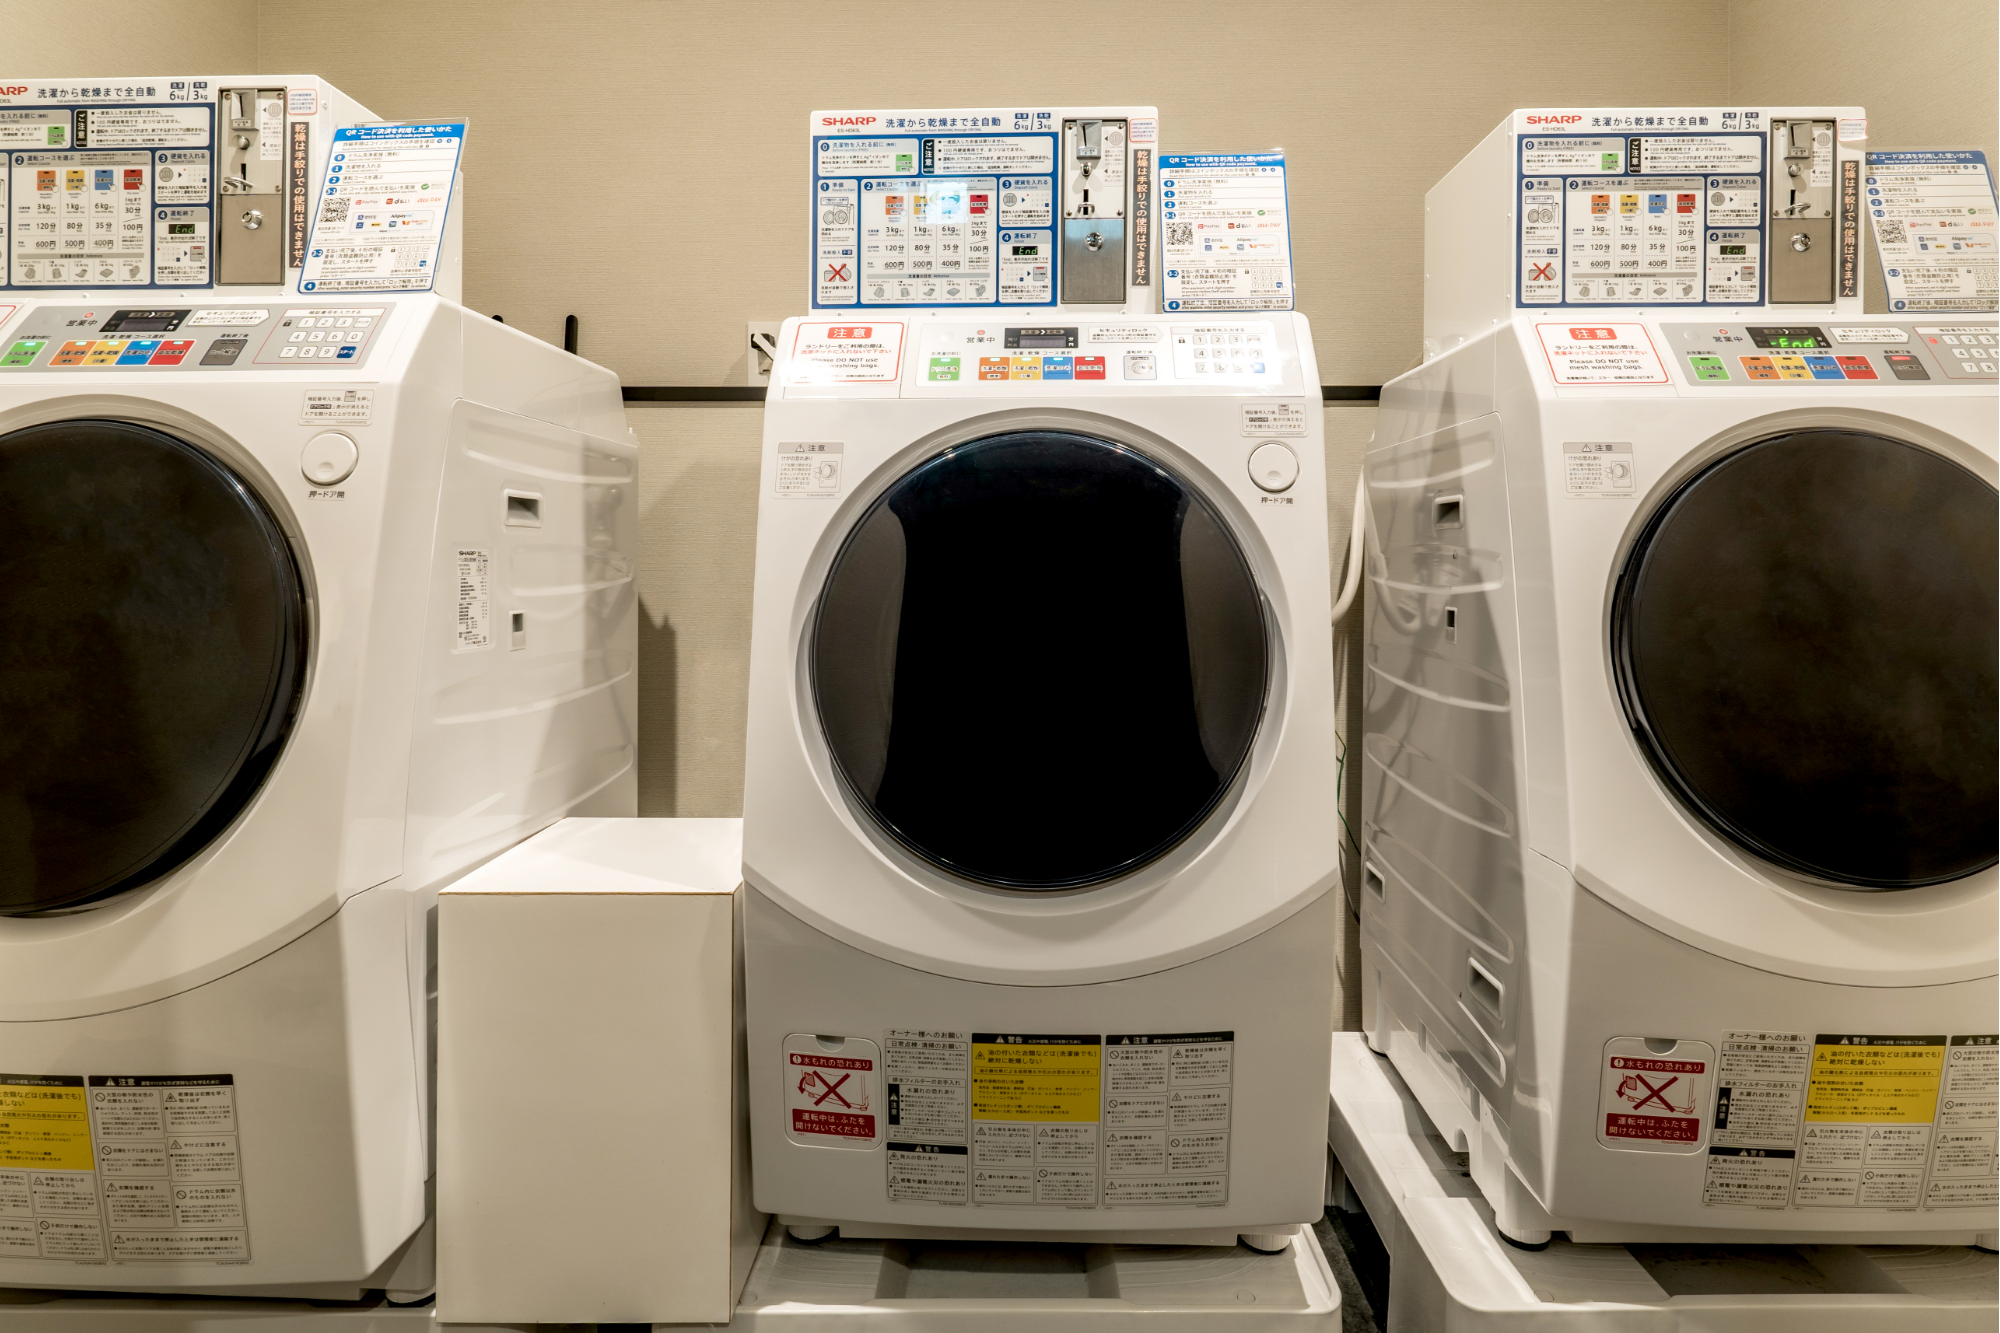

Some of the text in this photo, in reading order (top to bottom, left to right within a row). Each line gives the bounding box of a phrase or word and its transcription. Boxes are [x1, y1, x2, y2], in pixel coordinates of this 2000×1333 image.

[37, 86, 156, 99] 洗濯から乾燥まで全自動
[822, 117, 876, 126] SHARP
[885, 117, 1001, 128] 洗濯から乾燥まで全自動
[1526, 115, 1582, 124] SHARP
[1591, 117, 1709, 127] 洗濯から乾燥まで全自動
[77, 114, 86, 139] ご注意
[924, 142, 933, 166] ご注意
[1631, 141, 1639, 166] ご注意
[1581, 179, 1629, 187] 運転コースを選ぶ
[1722, 178, 1757, 186] 硬貨を入れる
[293, 124, 307, 267] 乾燥は手絞りでの使用はできません
[1136, 150, 1148, 284] 乾燥は手絞りでの使用はできません
[175, 225, 193, 233] End
[1843, 162, 1856, 296] 乾燥は手絞りでの使用はできません
[35, 240, 56, 248] 600円
[94, 239, 114, 247] 400円
[1018, 246, 1037, 255] End
[1726, 246, 1746, 254] End
[884, 261, 904, 269] 600円
[912, 260, 932, 268] 500円
[941, 260, 960, 268] 400円
[1590, 260, 1611, 268] 600円
[1619, 260, 1639, 268] 500円
[1647, 259, 1668, 267] 400円
[65, 319, 98, 327] 営業中
[833, 328, 866, 338] 注意
[1575, 329, 1610, 339] 注意
[1595, 444, 1614, 452] 注意
[890, 1030, 963, 1039] オーナー様へのお願い
[1728, 1033, 1806, 1042] オーナー様へのお願い
[891, 1041, 962, 1050] 日常点検・清掃のお願い
[1852, 1037, 1868, 1045] 警告
[1729, 1044, 1803, 1052] 日常点検・清掃のお願い
[988, 1049, 1097, 1057] 油の付いた衣類などは(洗濯後でも)
[803, 1057, 869, 1069] 水もれの恐れあり
[1626, 1060, 1701, 1071] 水もれの恐れあり
[118, 1078, 135, 1086] 注意
[892, 1077, 961, 1086] 排水フィルターのお手入れ
[1724, 1081, 1797, 1089] 排水フィルターのお手入れ
[907, 1087, 955, 1095] 水漏れの恐れあり
[1719, 1106, 1726, 1120] 注意
[802, 1112, 865, 1125] 運転中は、ふたを
[1617, 1117, 1688, 1129] 運転中は、ふたを
[796, 1122, 872, 1135] 開けないでください。
[1609, 1126, 1694, 1139] 開けないでください。
[1722, 1158, 1762, 1166] 発火の恐れあり
